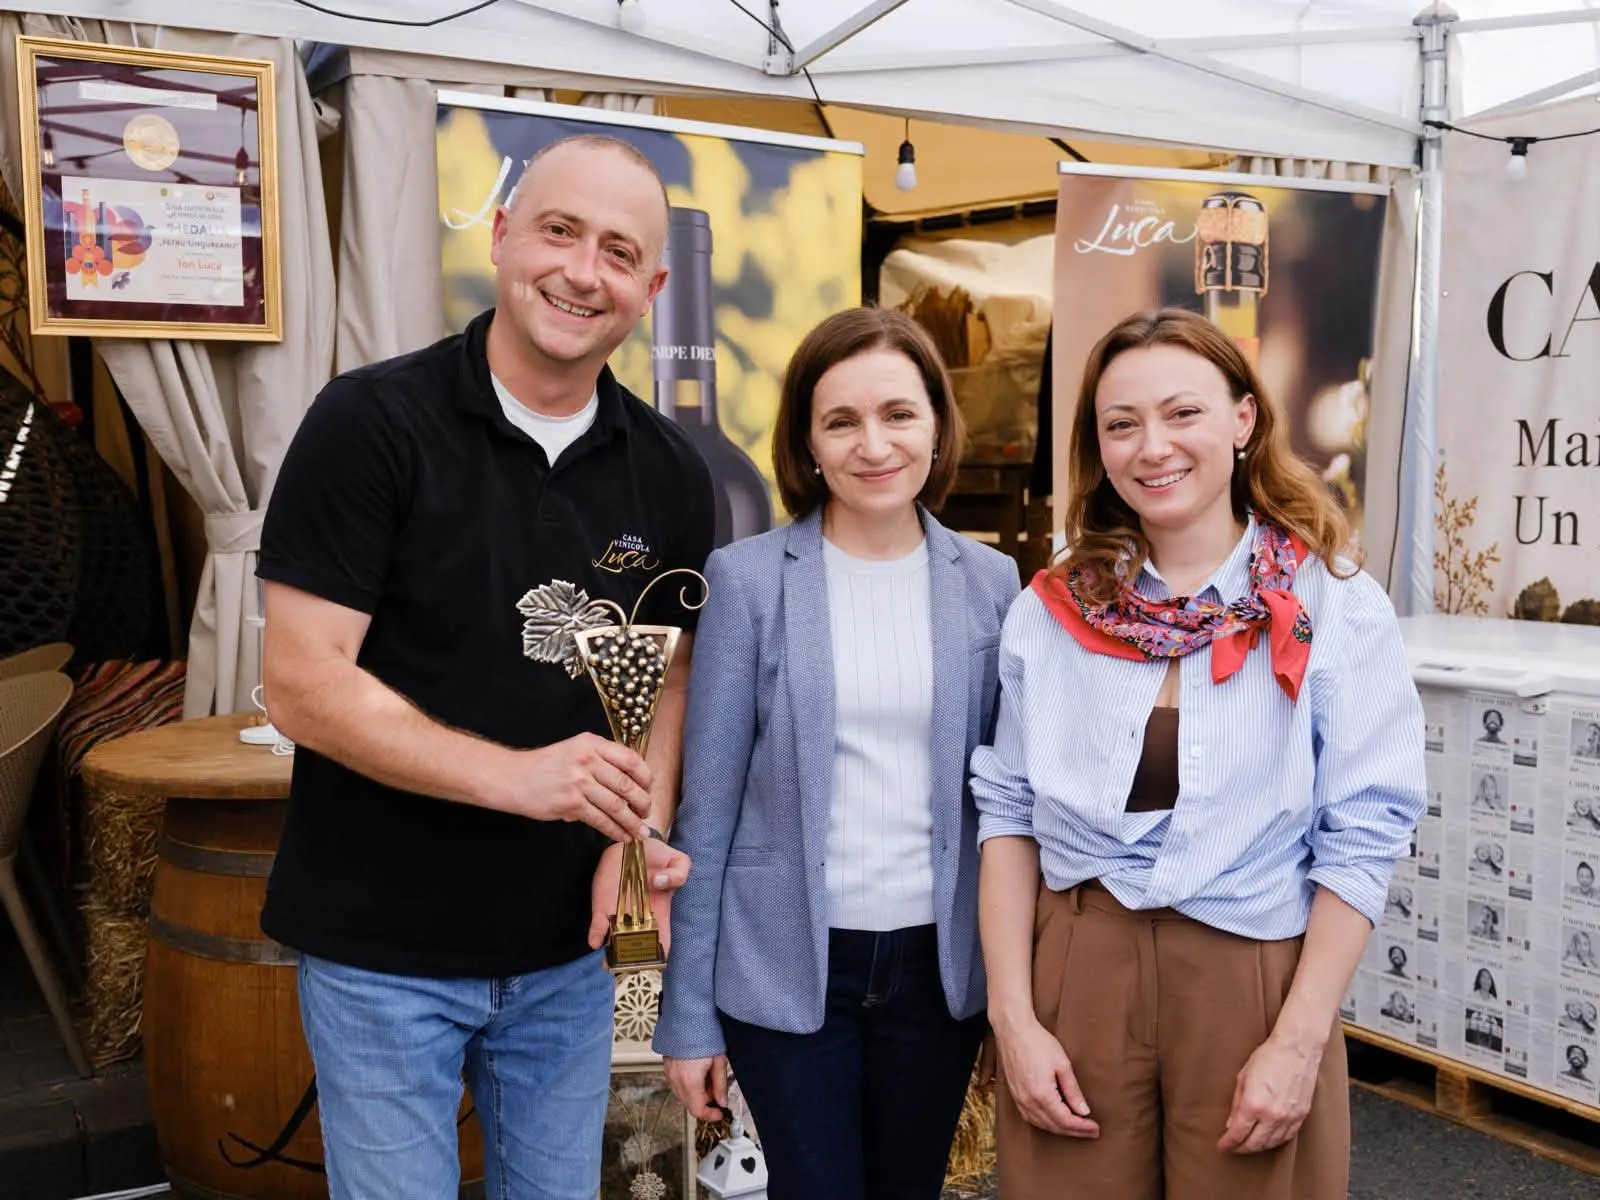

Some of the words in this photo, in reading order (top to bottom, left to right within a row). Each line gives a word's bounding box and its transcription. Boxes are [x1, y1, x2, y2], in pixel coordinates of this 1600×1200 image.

[1074, 203, 1199, 256] Luca
[1512, 495, 1581, 546] Un
[614, 540, 650, 553] VINICOLA
[622, 534, 642, 544] CASA
[591, 540, 660, 573] Luca
